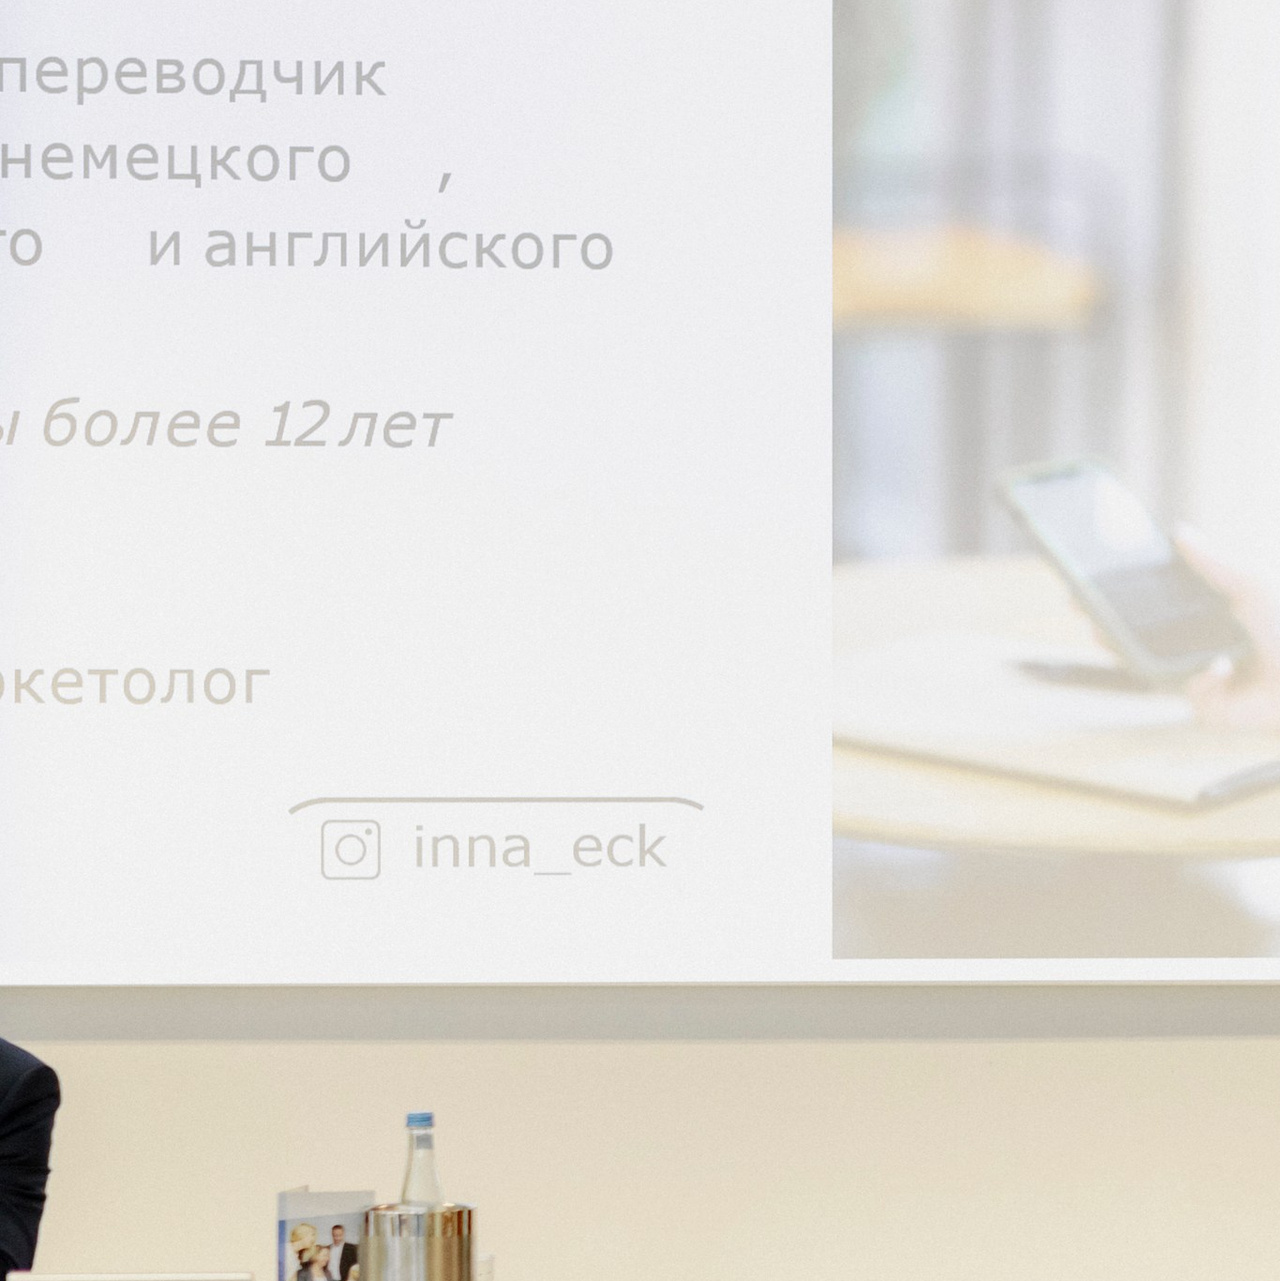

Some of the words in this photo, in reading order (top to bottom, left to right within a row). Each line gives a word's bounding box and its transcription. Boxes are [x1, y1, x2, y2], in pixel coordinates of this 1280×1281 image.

[0, 56, 387, 106] переводчик
[1, 142, 351, 188] немецкого
[0, 228, 43, 267] о
[149, 229, 181, 266] и
[204, 218, 613, 270] английского
[43, 396, 241, 448] более
[0, 667, 271, 705] кетолог
[415, 823, 667, 876] inna_eck
